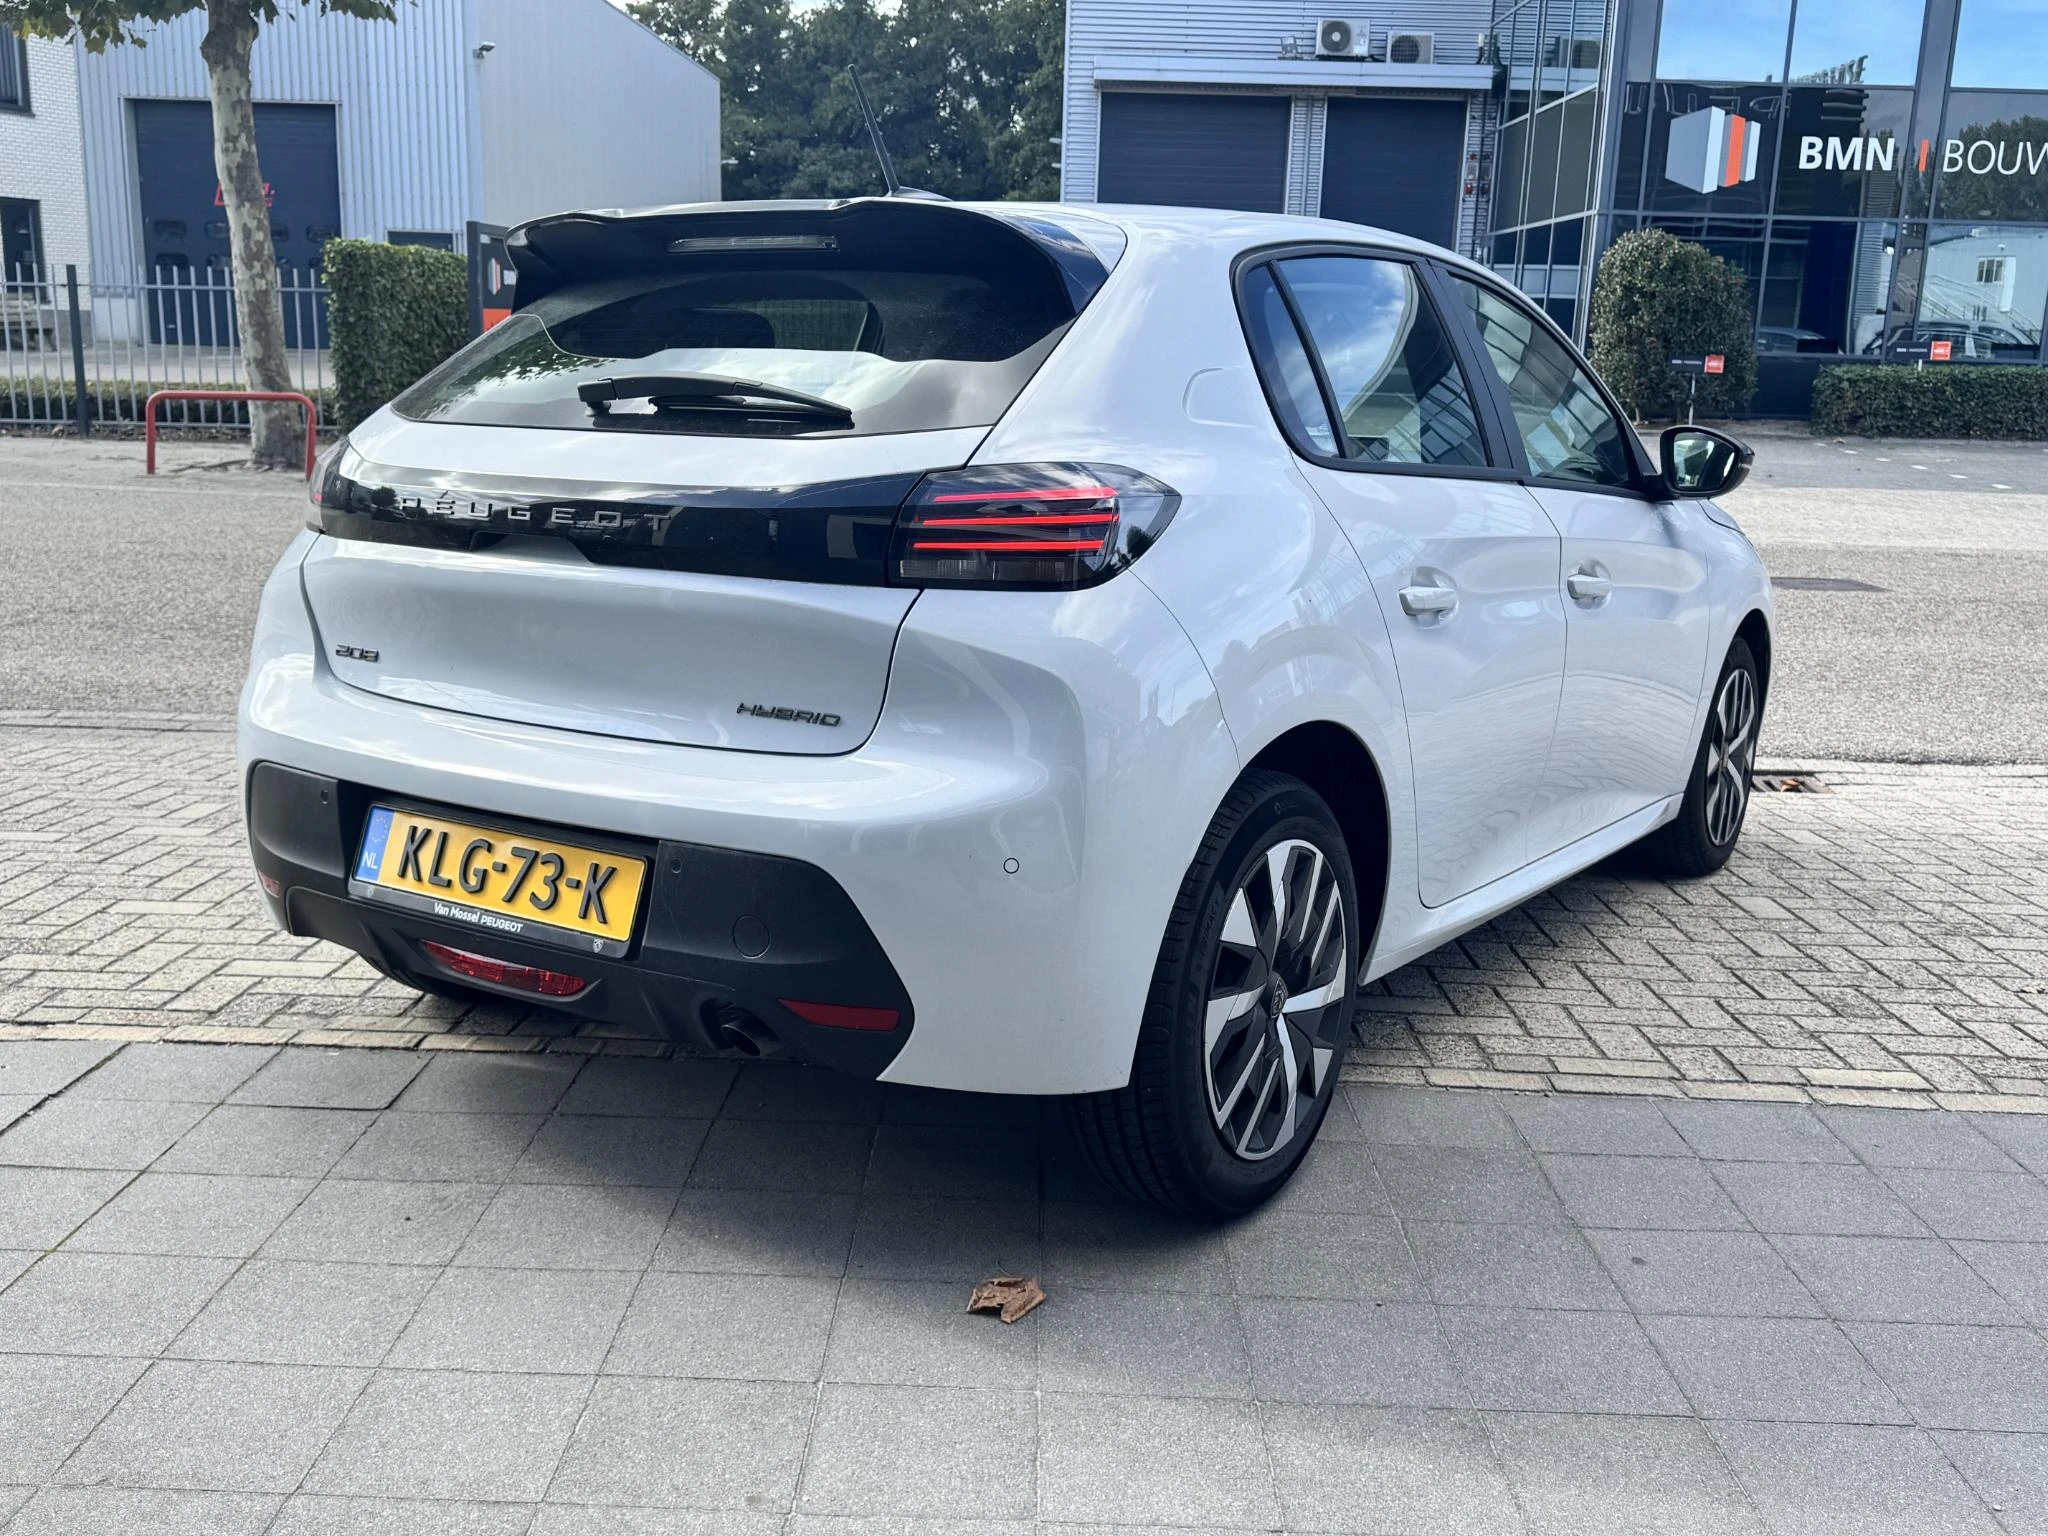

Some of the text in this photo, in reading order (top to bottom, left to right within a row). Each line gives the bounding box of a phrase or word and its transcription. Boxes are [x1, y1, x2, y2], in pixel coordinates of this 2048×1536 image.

[1798, 135, 1895, 171] BMN
[400, 497, 672, 531] PEUGEOT
[335, 644, 380, 663] 208
[736, 702, 842, 727] HYBRID
[361, 851, 379, 870] NL
[397, 825, 617, 924] KLG-73-K
[434, 902, 523, 933] Van Mossel PEUGEOT
